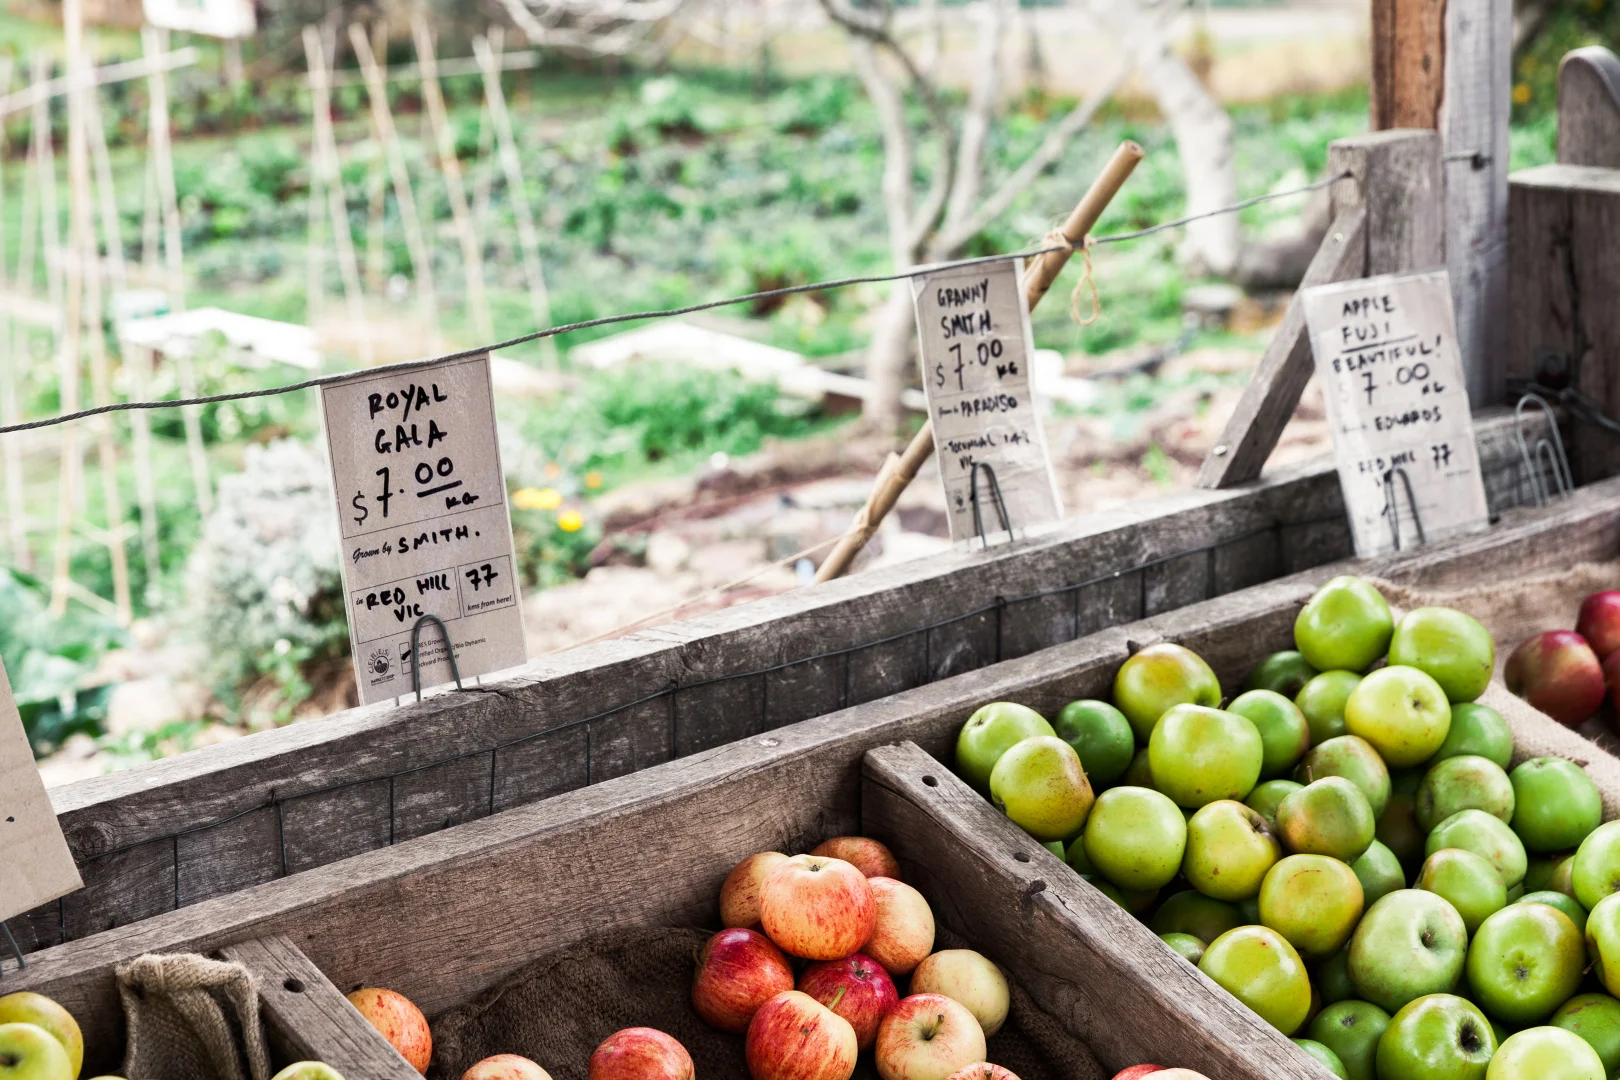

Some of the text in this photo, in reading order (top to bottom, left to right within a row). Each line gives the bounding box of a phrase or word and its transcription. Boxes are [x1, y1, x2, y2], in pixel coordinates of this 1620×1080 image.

[937, 278, 989, 308] GRANNY
[1342, 295, 1395, 317] APPLE
[941, 309, 992, 339] SMITH
[1342, 322, 1390, 345] FUJI
[1332, 334, 1442, 373] BEAUTIFUL!
[996, 361, 1018, 379] KG
[367, 383, 448, 423] ROYAL
[960, 393, 1018, 418] PARADISO
[1374, 405, 1443, 431] EDWARDS
[374, 419, 448, 454] GALA
[1431, 443, 1451, 470] 77
[352, 524, 481, 564] Grown by SMITH.
[465, 563, 499, 592] 77
[355, 573, 451, 611] in RED HILL
[467, 595, 512, 611] kms from here!
[393, 603, 425, 623] VIC
[464, 637, 487, 647] Dynamic
